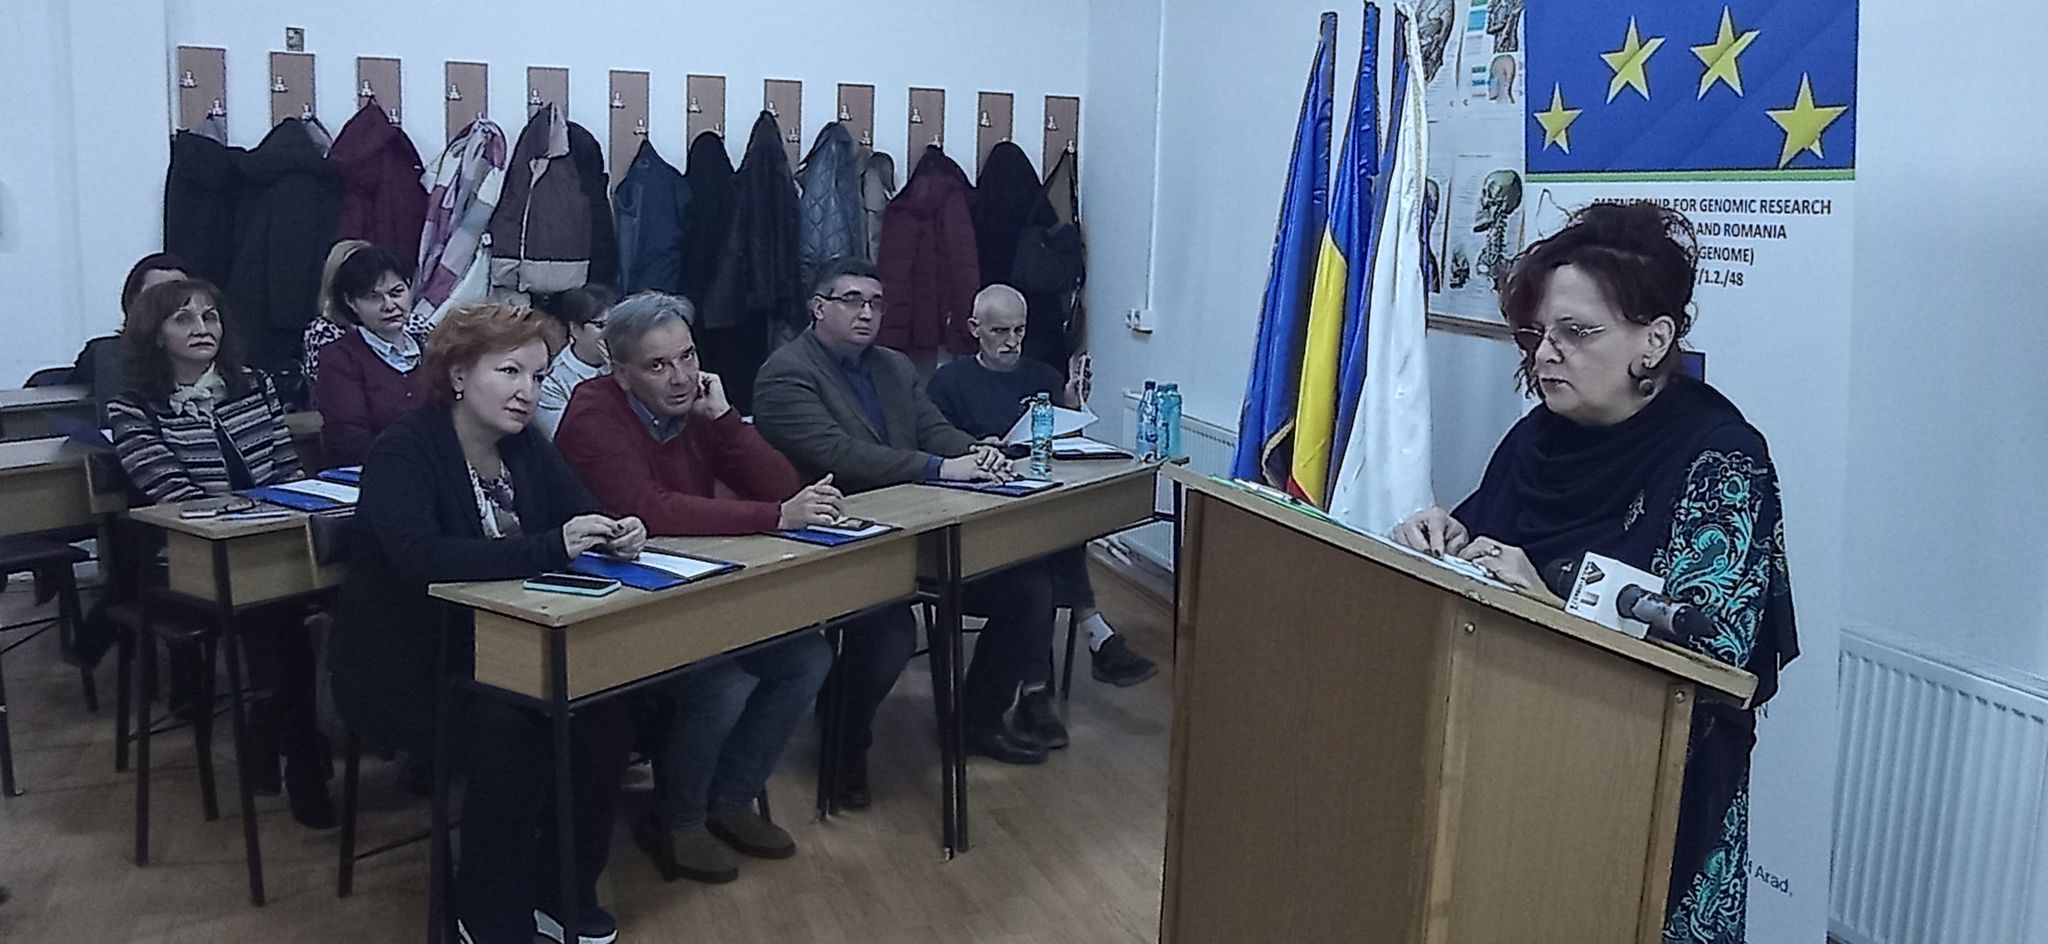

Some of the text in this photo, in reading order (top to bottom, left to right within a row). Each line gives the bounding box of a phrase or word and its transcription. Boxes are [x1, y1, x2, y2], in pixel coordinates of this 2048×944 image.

[1674, 199, 1696, 213] FOR
[1699, 199, 1756, 213] GENOMIC
[1760, 199, 1831, 215] RESEARCH
[1696, 222, 1721, 236] AND
[1724, 223, 1787, 239] ROMANIA
[1694, 268, 1744, 287] /1.2./48
